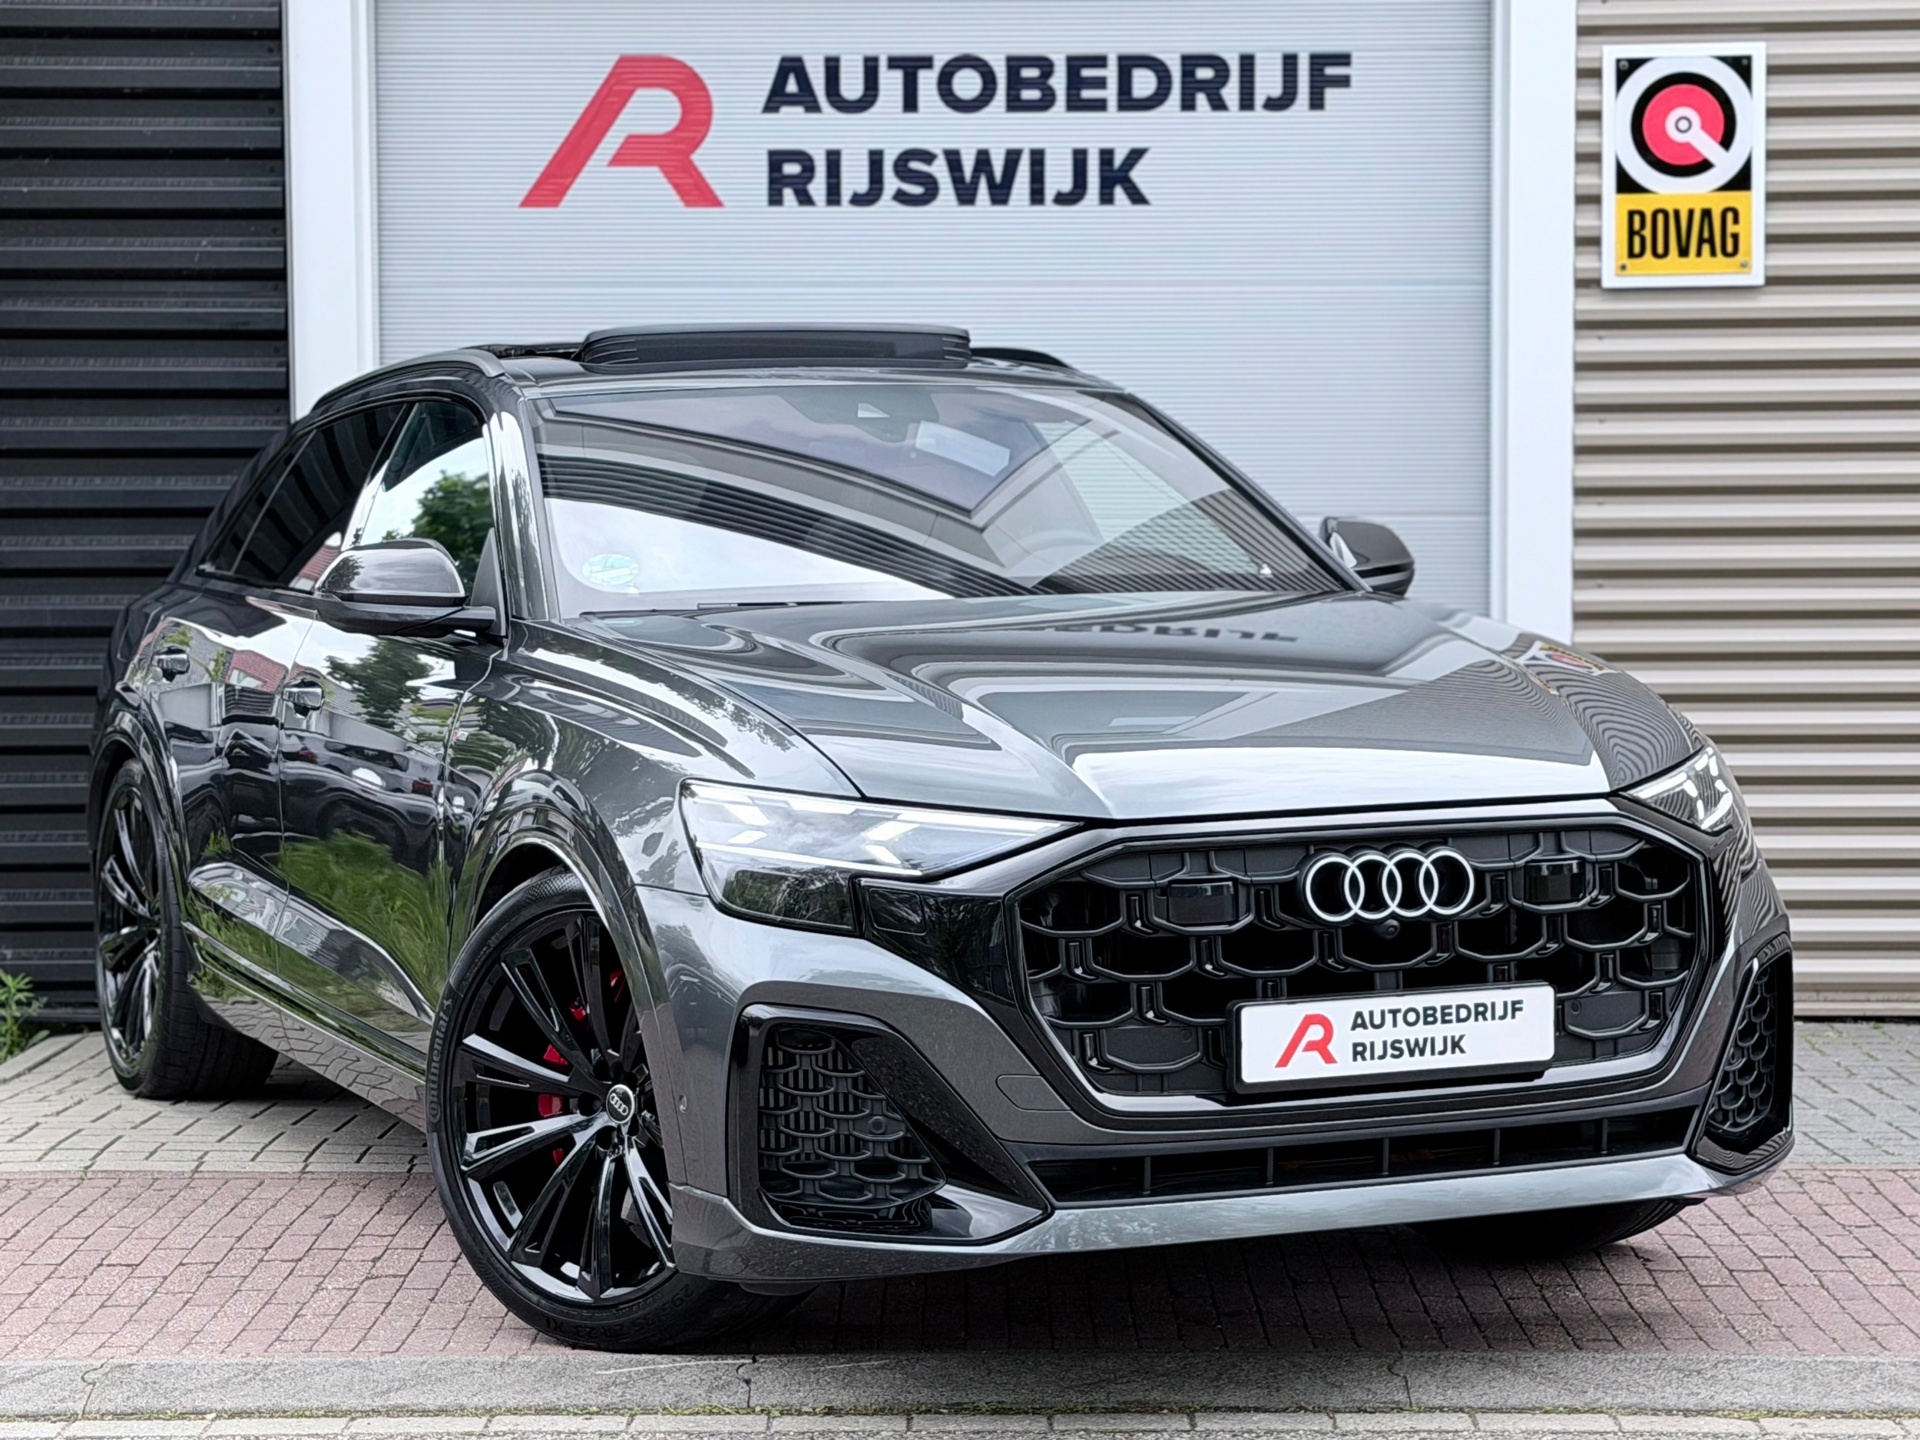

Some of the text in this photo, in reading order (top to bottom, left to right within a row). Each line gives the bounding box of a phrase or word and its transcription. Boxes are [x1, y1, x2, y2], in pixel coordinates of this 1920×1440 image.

[762, 52, 1353, 114] AUTOBEDRIJF
[767, 148, 1151, 207] RIJSWIJK
[1627, 207, 1740, 259] BOVAG
[1350, 999, 1524, 1031] AUTOBEDRIJF
[1352, 1033, 1466, 1062] RIJSWIJK
